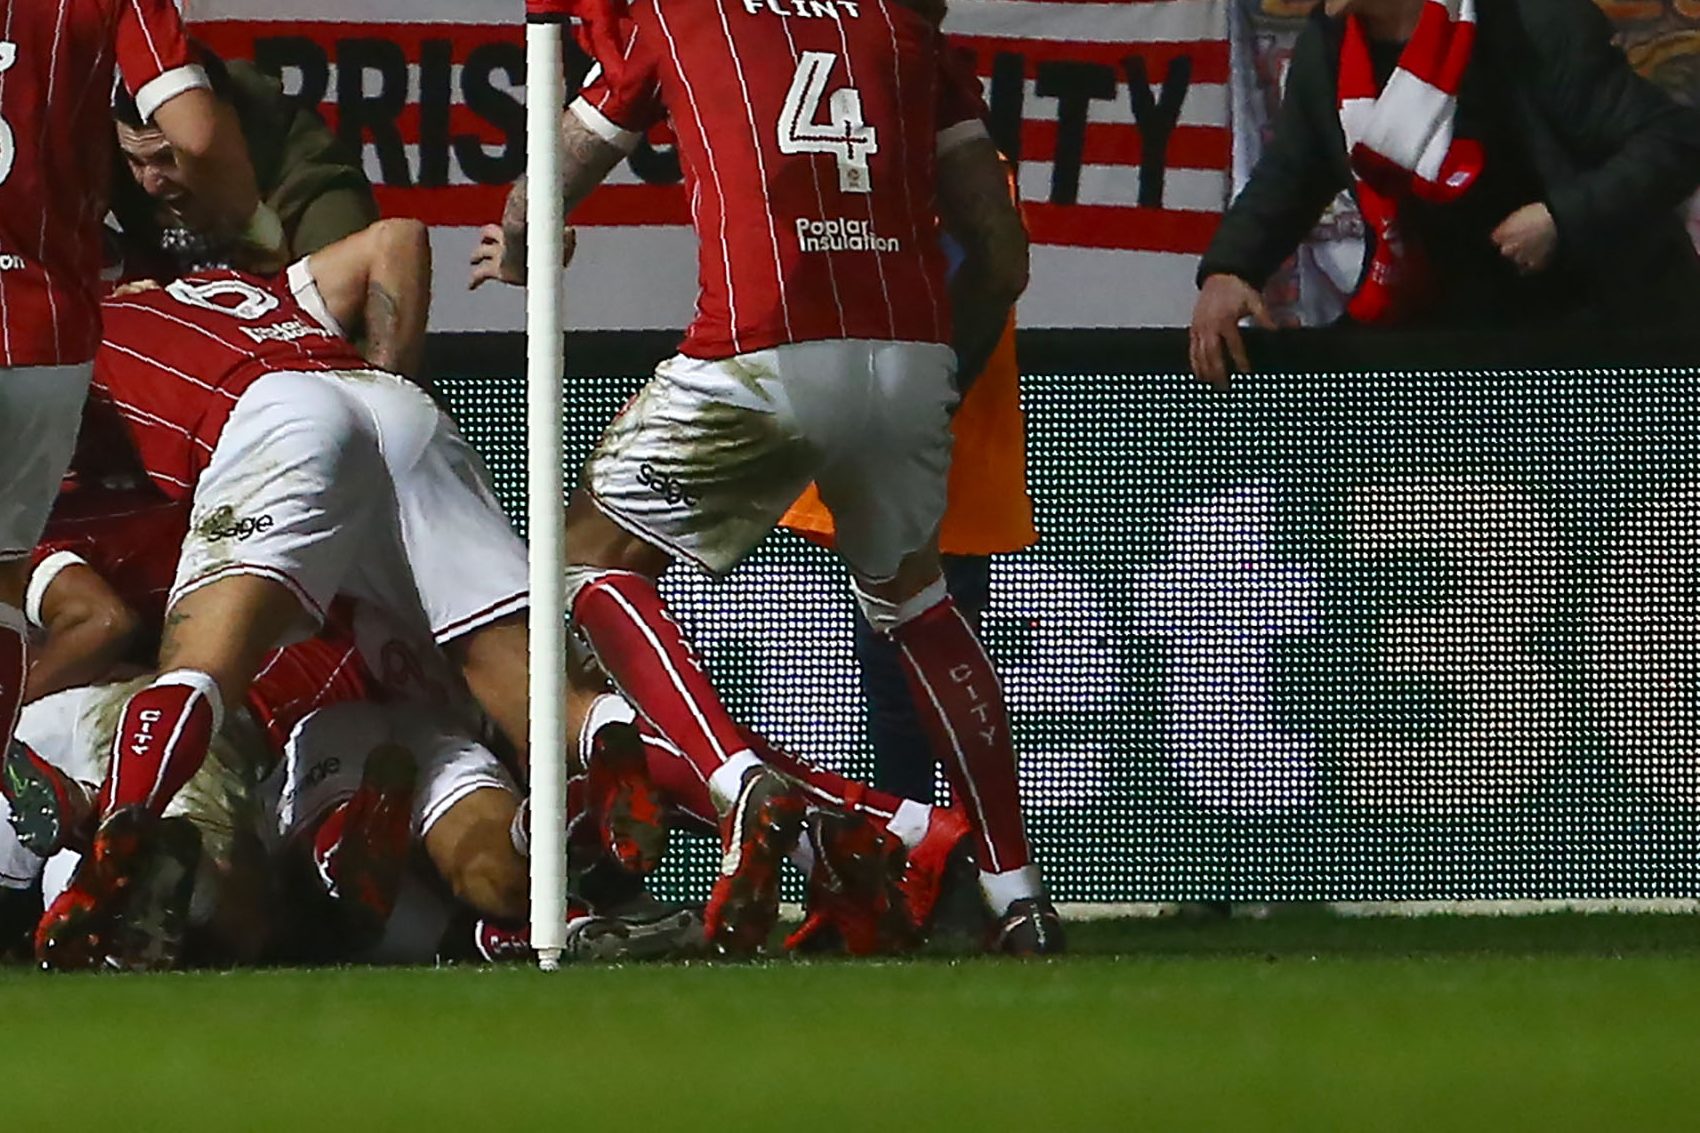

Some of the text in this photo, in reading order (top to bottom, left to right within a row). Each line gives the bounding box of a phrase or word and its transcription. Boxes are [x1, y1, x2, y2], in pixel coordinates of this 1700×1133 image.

[777, 50, 878, 194] 4
[986, 51, 1193, 208] ITY
[795, 217, 870, 238] Poplar
[799, 233, 900, 253] Insulation
[207, 514, 274, 542] sage
[948, 664, 996, 746] CITY
[131, 709, 162, 755] CITY
